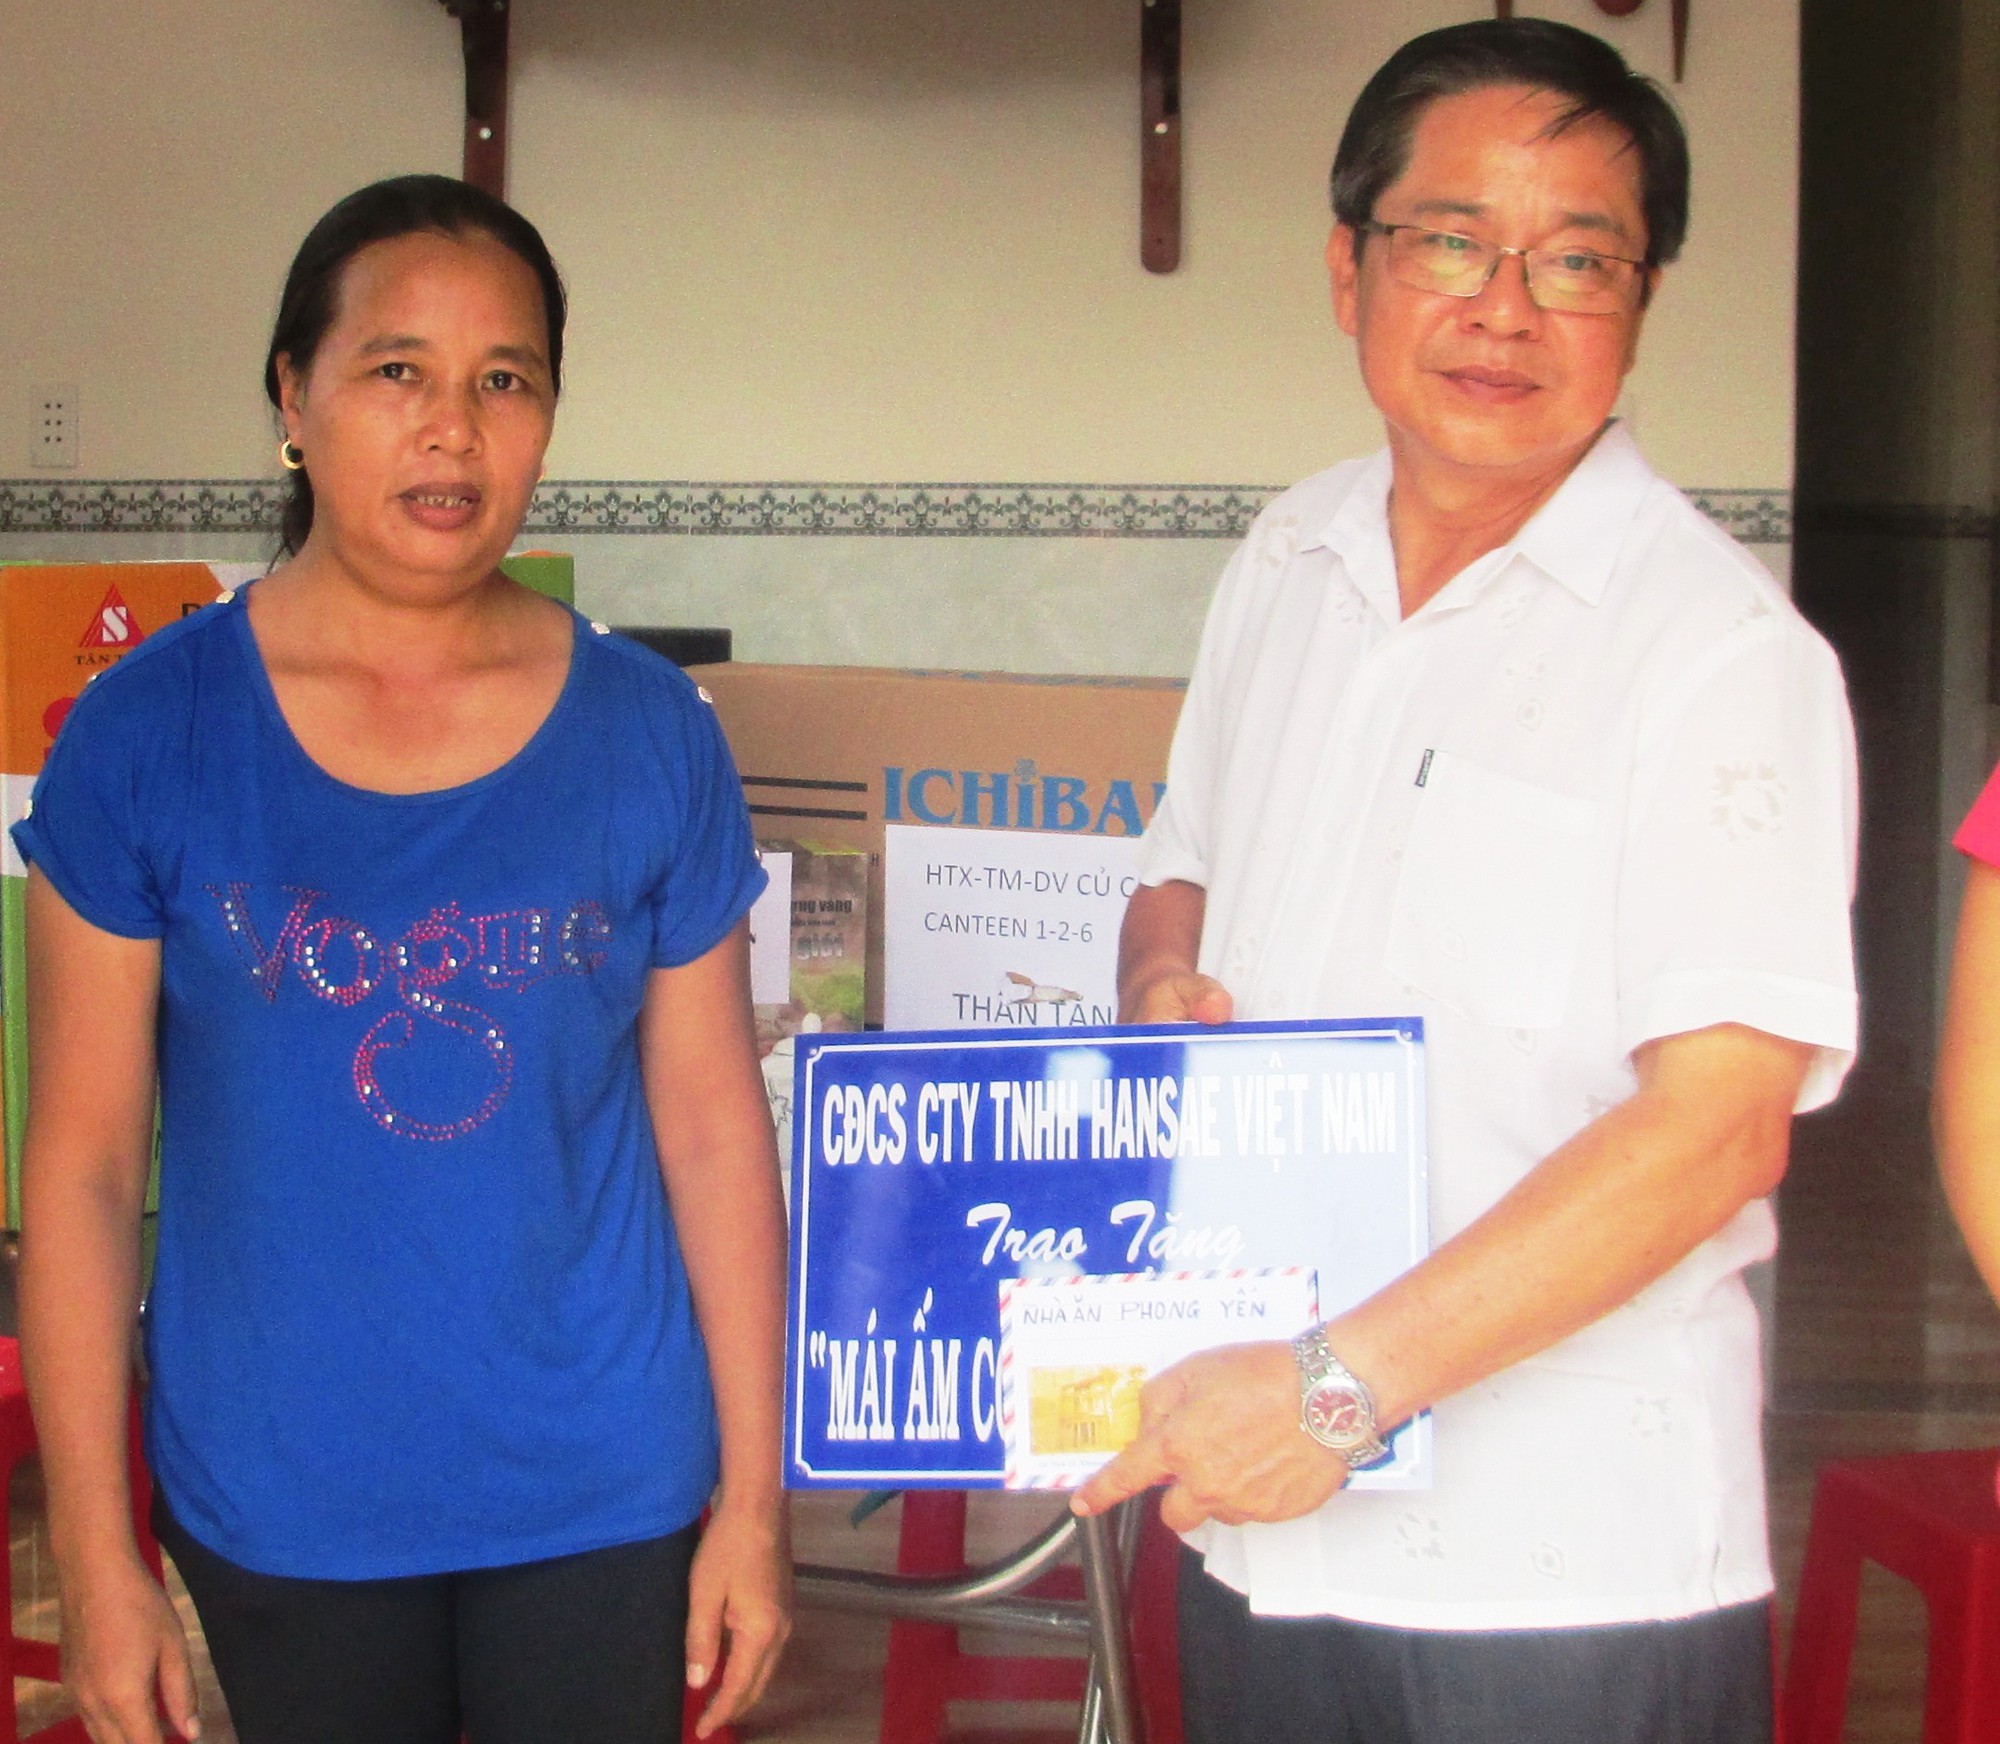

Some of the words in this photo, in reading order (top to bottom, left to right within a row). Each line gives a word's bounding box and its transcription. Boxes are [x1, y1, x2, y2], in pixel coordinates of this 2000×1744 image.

[925, 863, 1069, 895] HTX-TM-DV
[1076, 866, 1111, 898] CỦ
[924, 911, 1028, 938] CANTEEN
[1035, 919, 1094, 943] 1-2-6
[821, 1082, 907, 1166] CĐCS
[916, 1081, 980, 1163] CTY
[990, 1078, 1079, 1161] TNHH
[1091, 1073, 1221, 1160] HANSAE
[1232, 1051, 1310, 1173] VIỆT
[1321, 1071, 1397, 1155] NAM
[966, 1202, 1088, 1265] Trao
[1120, 1300, 1201, 1320] PHONG
[903, 1286, 962, 1441] ẤM
